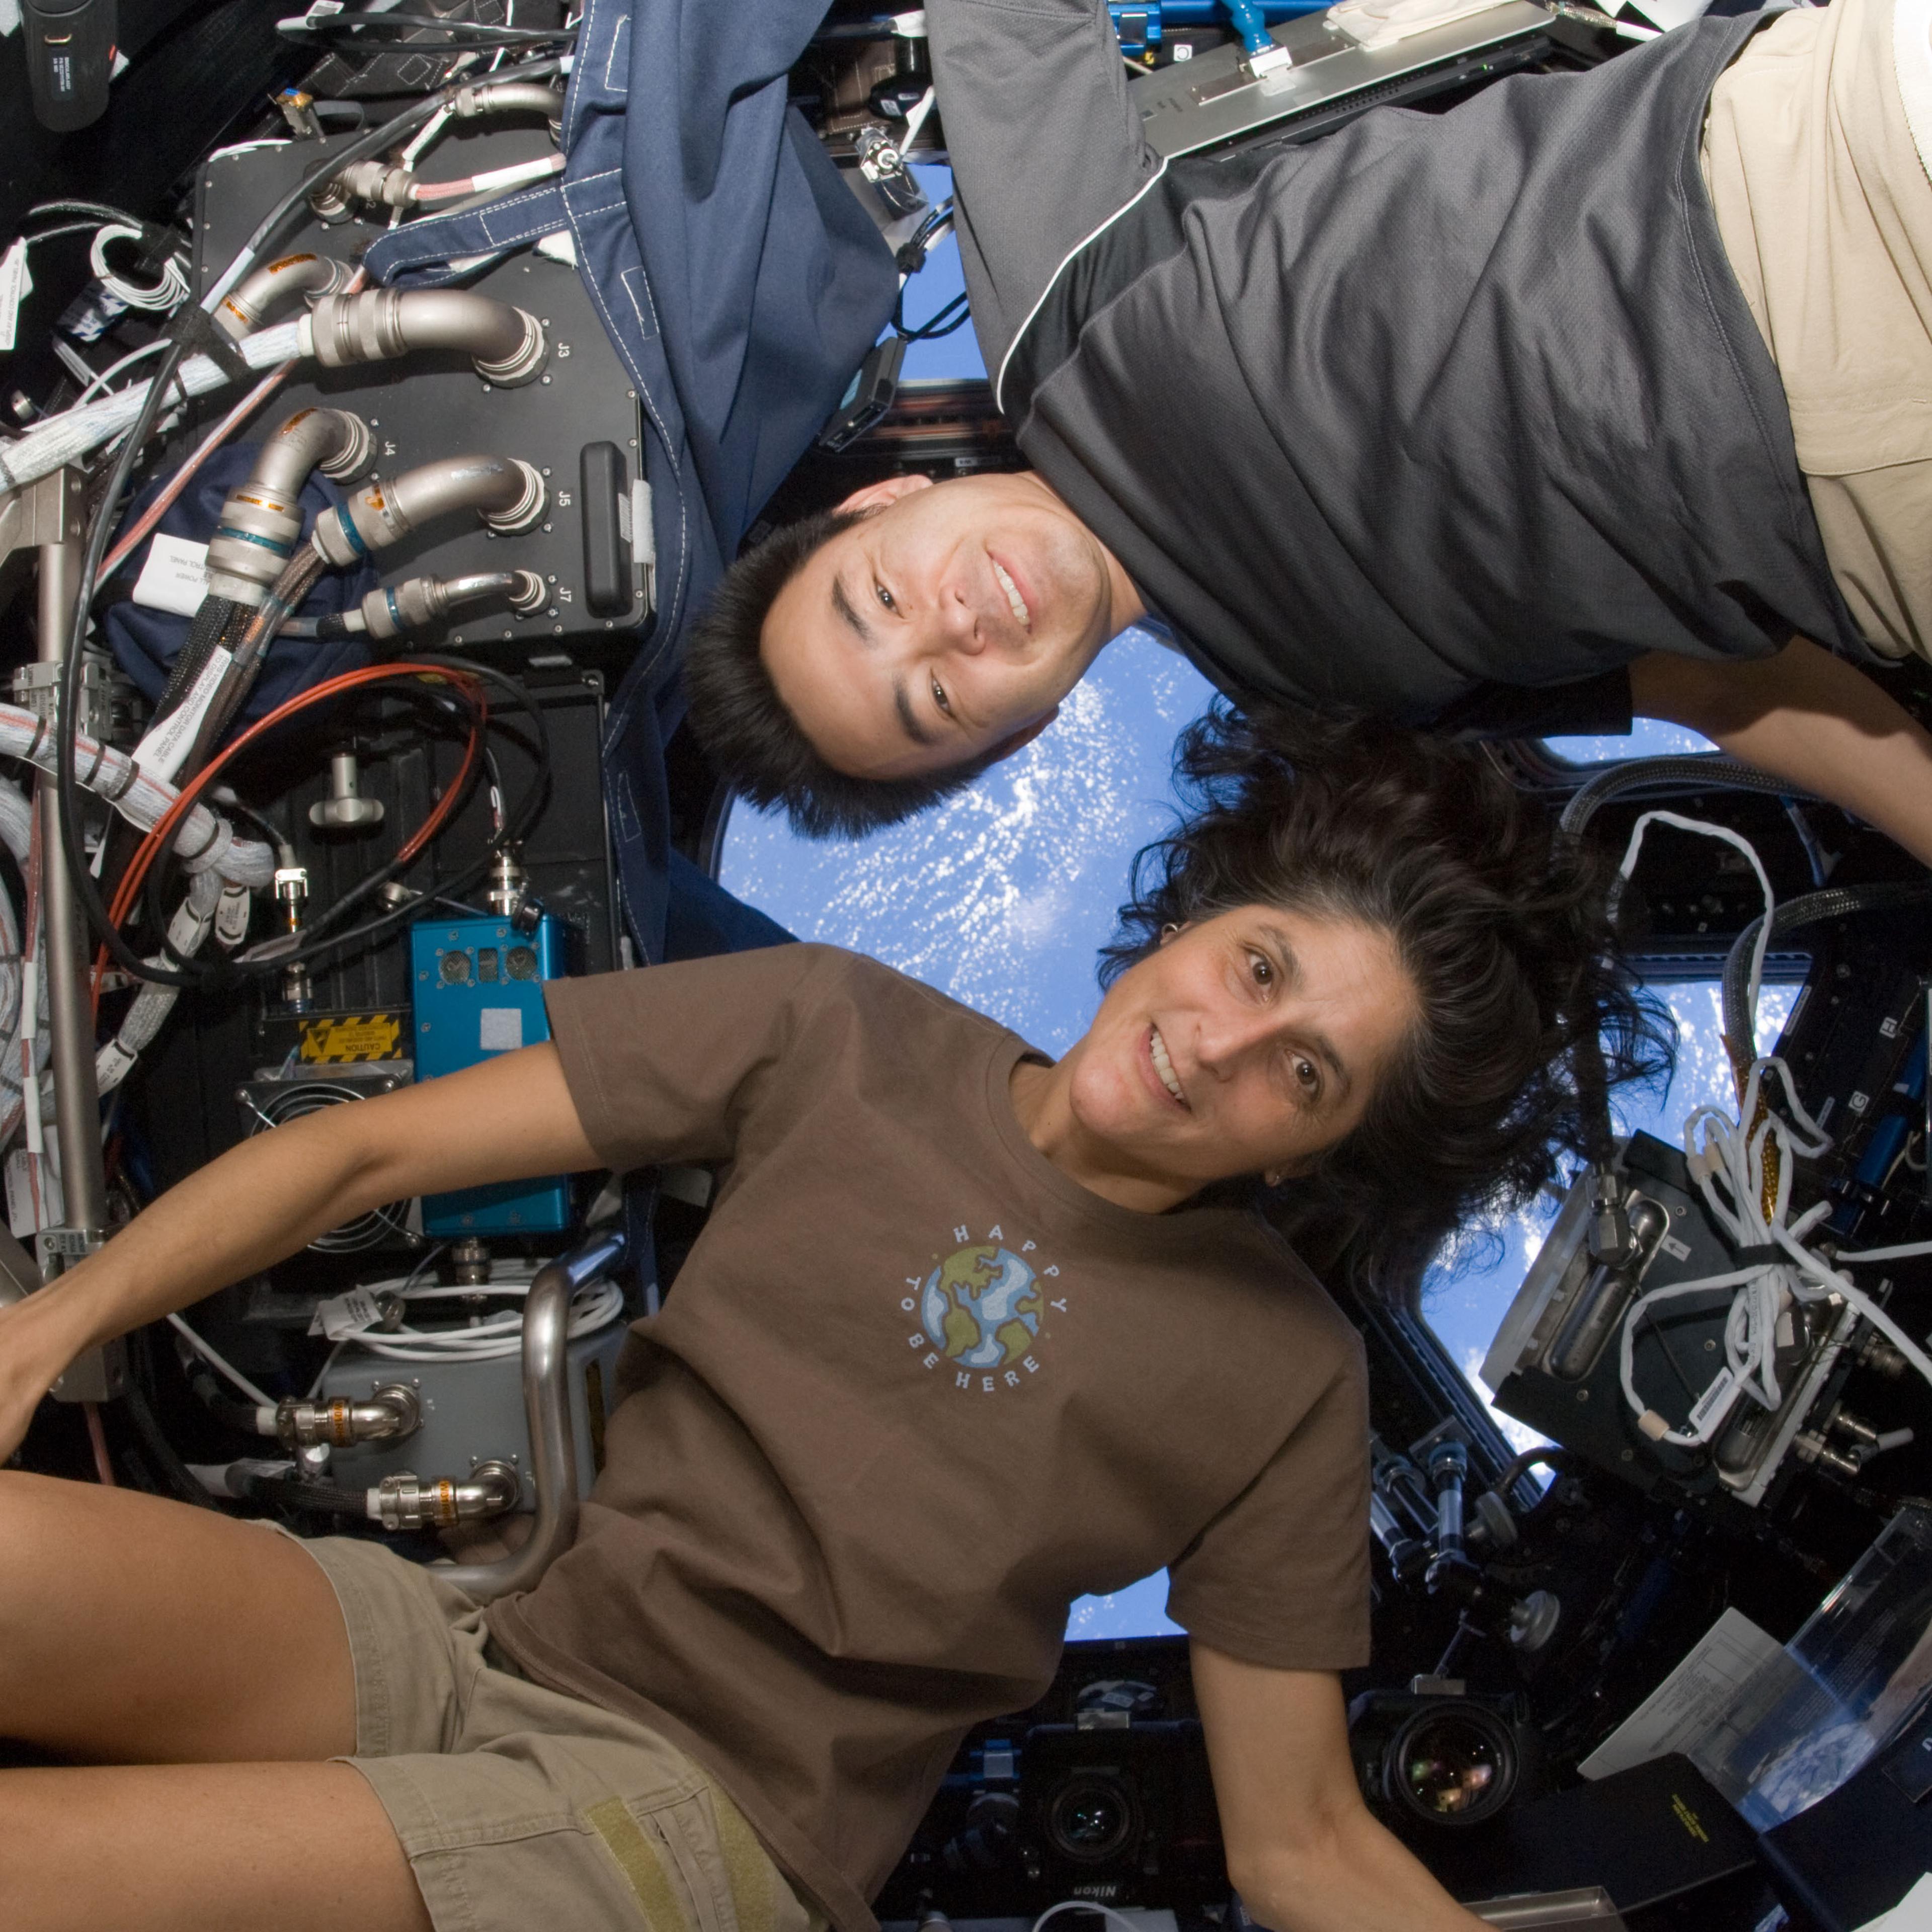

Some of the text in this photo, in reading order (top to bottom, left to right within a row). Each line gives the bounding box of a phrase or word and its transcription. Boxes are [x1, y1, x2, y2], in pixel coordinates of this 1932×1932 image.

[1177, 47, 1189, 60] C
[558, 343, 570, 358] J3
[385, 441, 396, 456] J4
[558, 491, 570, 507] J5
[560, 587, 572, 603] J7
[202, 672, 219, 696] VIDEO
[153, 653, 224, 758] TO DISPLAY AND CONTROL PANEL
[183, 694, 206, 726] MONITOR
[171, 725, 186, 743] DATA
[157, 741, 175, 764] CABLE
[1882, 1020, 1896, 1033] H
[346, 1042, 380, 1052] CAUTION
[1852, 1094, 1867, 1109] G
[954, 1225, 1067, 1312] HAPPY
[909, 1333, 939, 1369] BE
[956, 1355, 1040, 1391] HERE
[1073, 1885, 1116, 1897] Nikon
